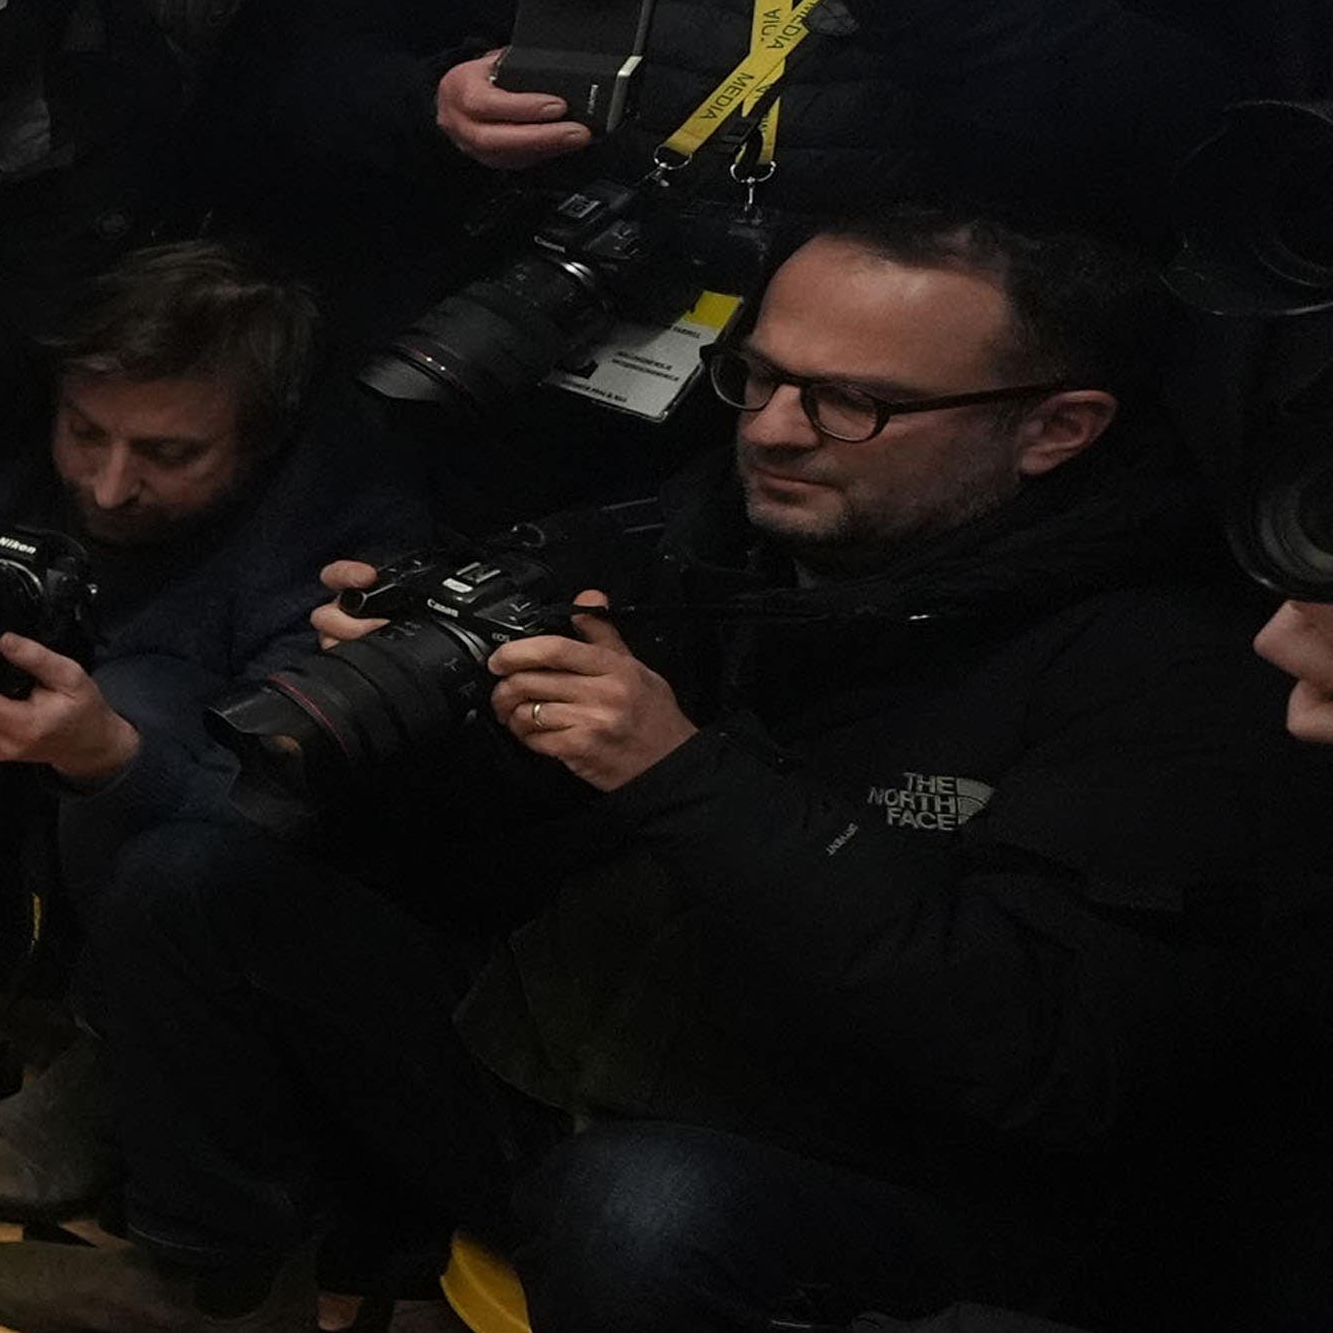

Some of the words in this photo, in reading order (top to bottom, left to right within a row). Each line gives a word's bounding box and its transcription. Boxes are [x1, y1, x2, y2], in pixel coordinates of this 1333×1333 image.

[700, 71, 755, 120] MEDIA
[902, 771, 956, 794] THE
[866, 786, 957, 814] NORTH
[886, 807, 958, 832] FACE
